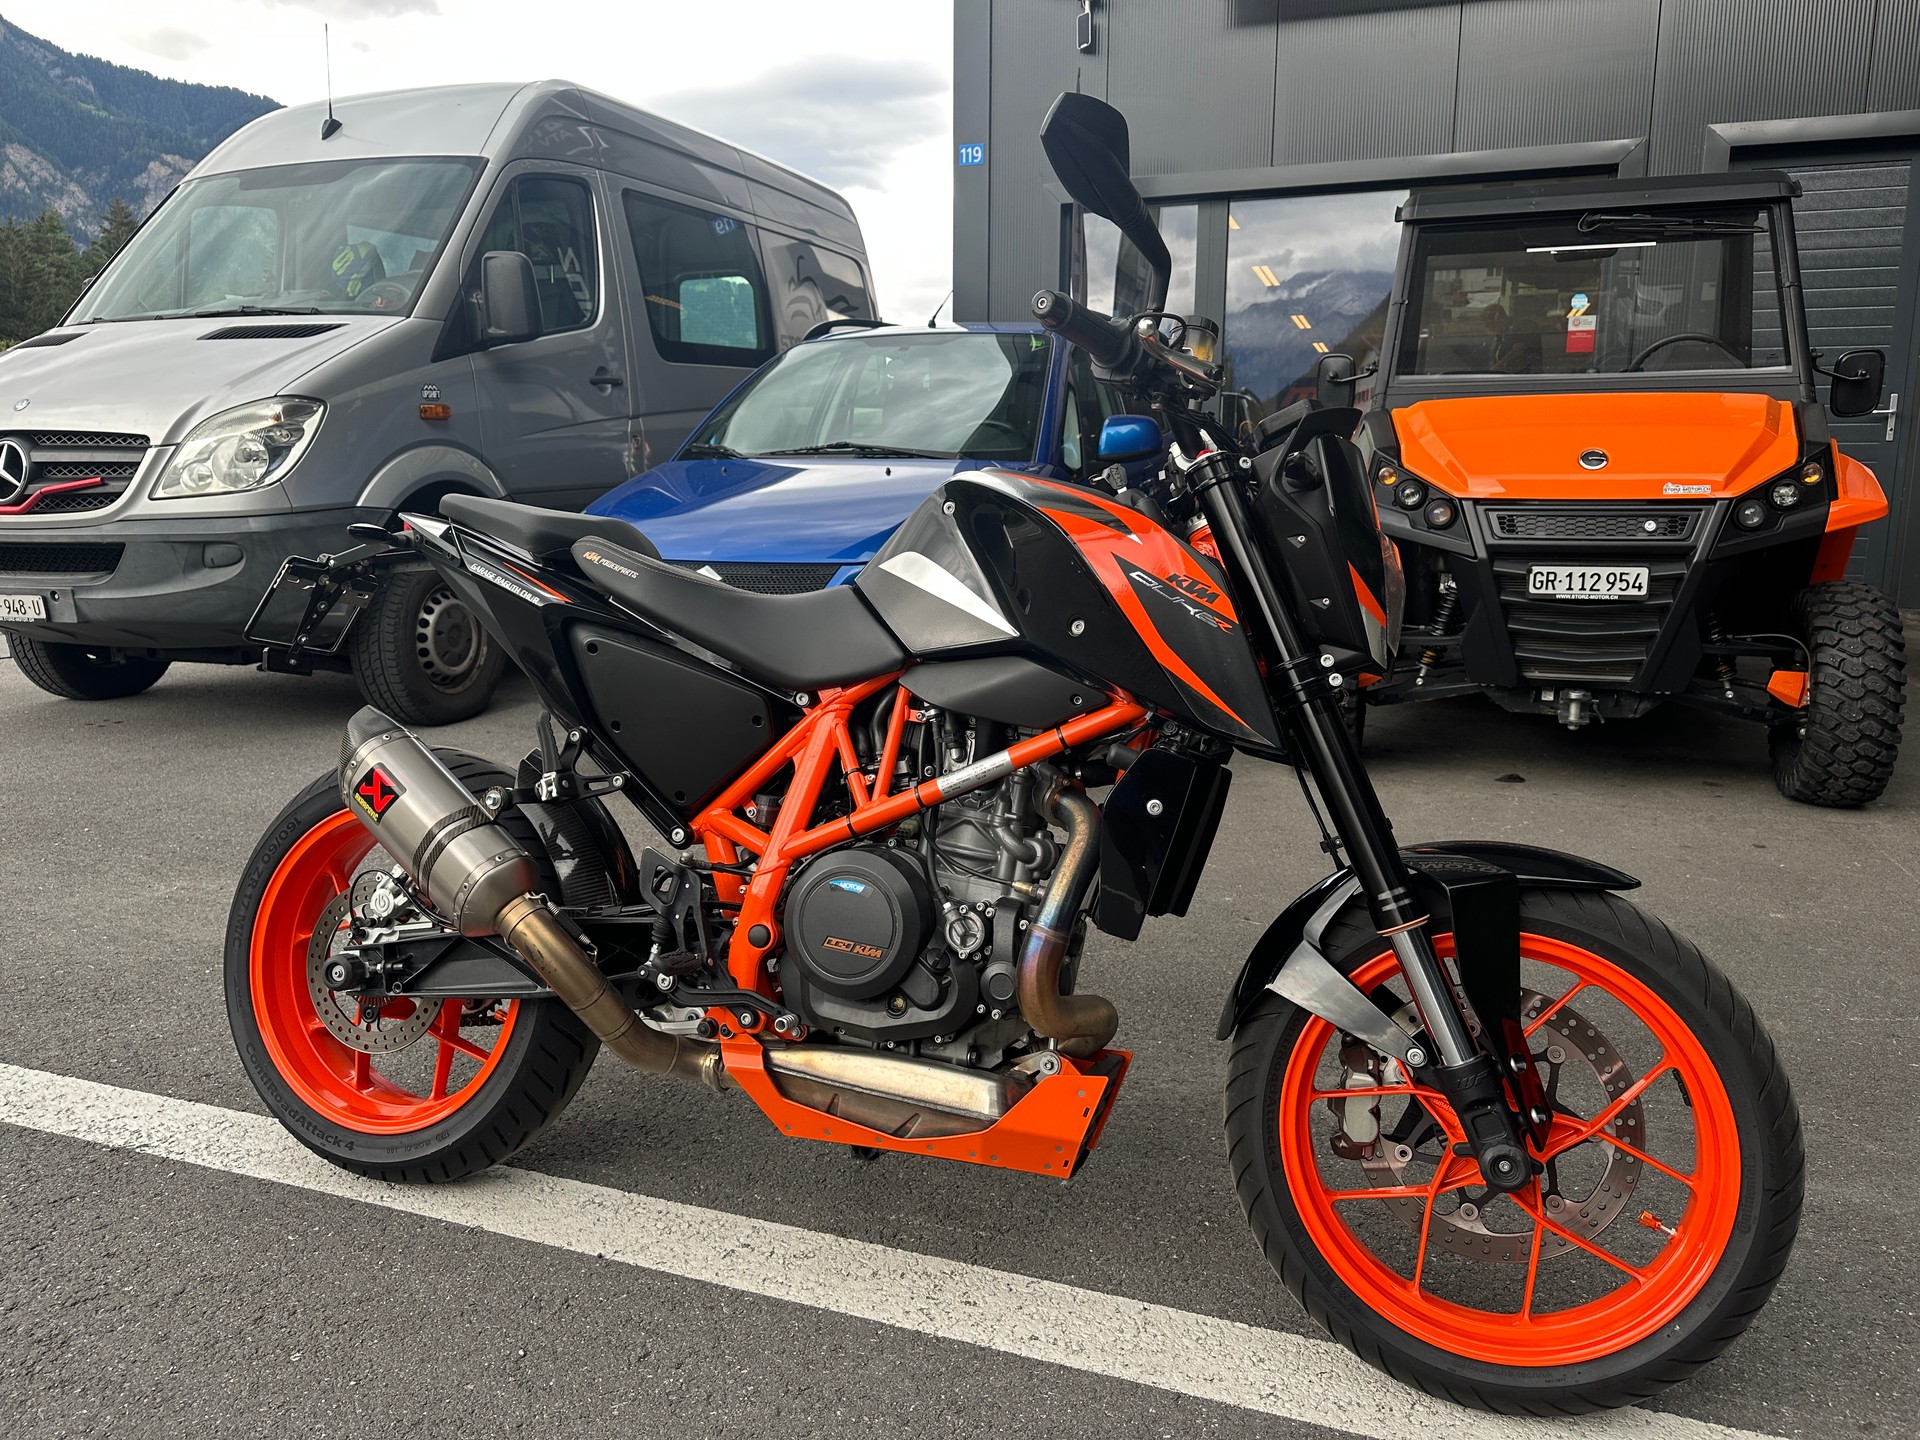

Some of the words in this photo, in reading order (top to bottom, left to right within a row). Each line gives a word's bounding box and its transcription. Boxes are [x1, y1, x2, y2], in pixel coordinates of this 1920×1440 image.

[960, 146, 982, 164] 119
[470, 563, 497, 581] GARAGE
[599, 558, 639, 579] POWERPARTS
[1165, 573, 1220, 604] KTM
[853, 944, 883, 959] KTM
[246, 1042, 342, 1148] ContiRoadAttack
[344, 1140, 356, 1151] 4
